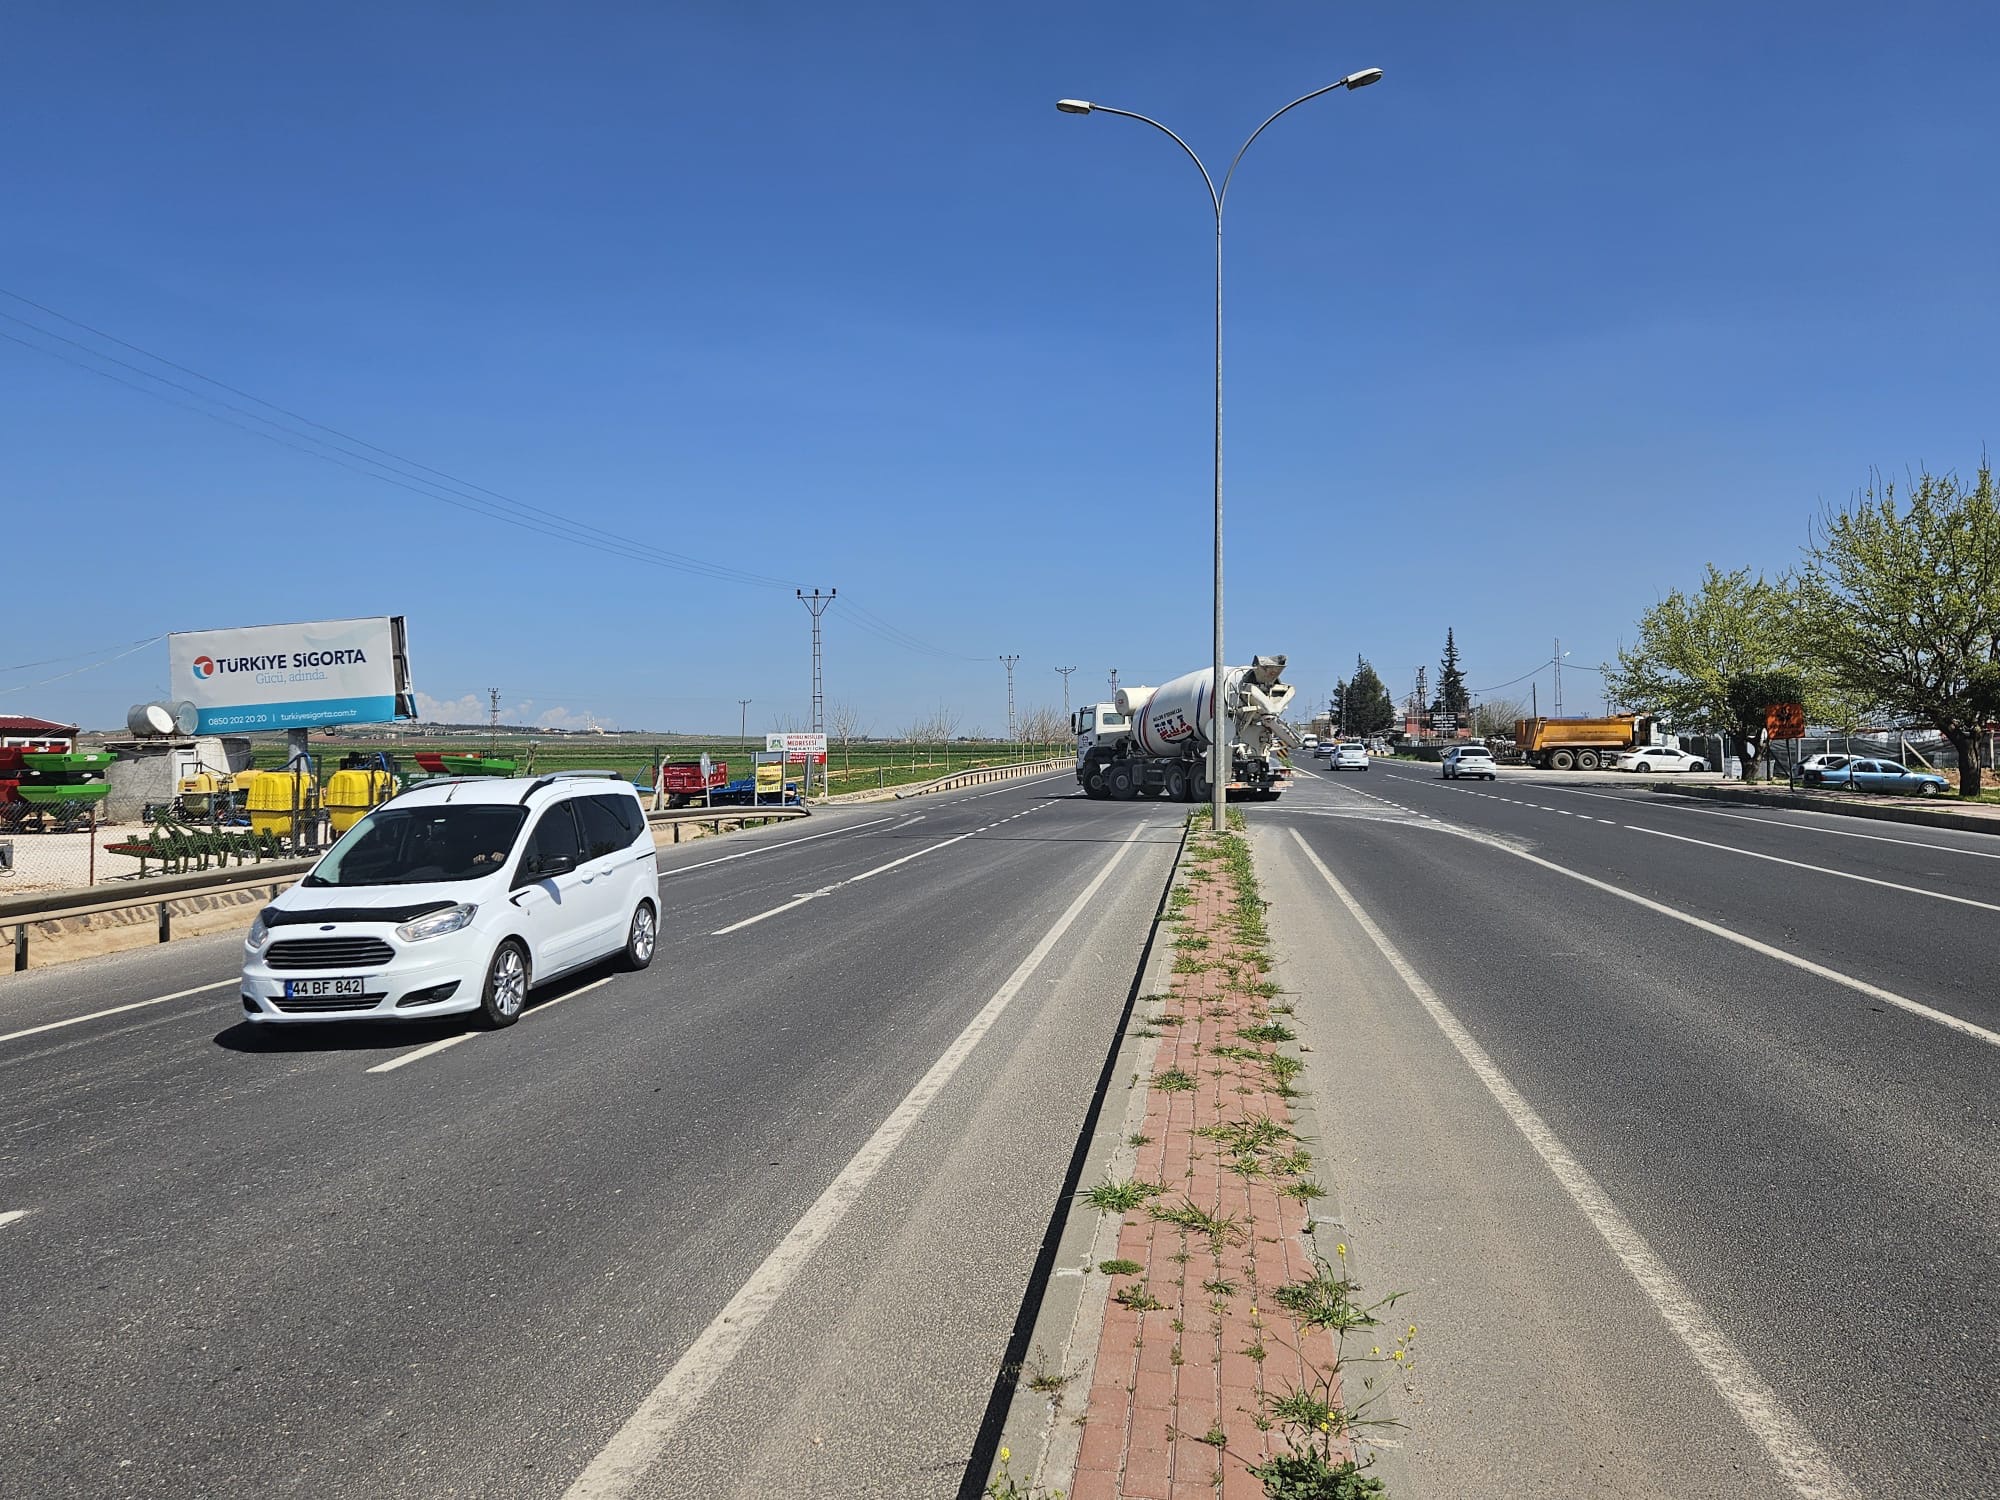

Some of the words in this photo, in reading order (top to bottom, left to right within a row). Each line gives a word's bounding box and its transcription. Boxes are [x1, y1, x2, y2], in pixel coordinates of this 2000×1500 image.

[255, 672, 287, 685] Gücü,
[288, 669, 328, 683] adında.
[208, 717, 229, 726] 0850
[229, 716, 244, 725] 202
[244, 715, 255, 724] 20
[256, 714, 267, 723] 20
[280, 710, 357, 721] turkiyesigorta.com.tr
[293, 982, 308, 995] 44
[313, 981, 331, 994] BF
[336, 980, 360, 993] 842
